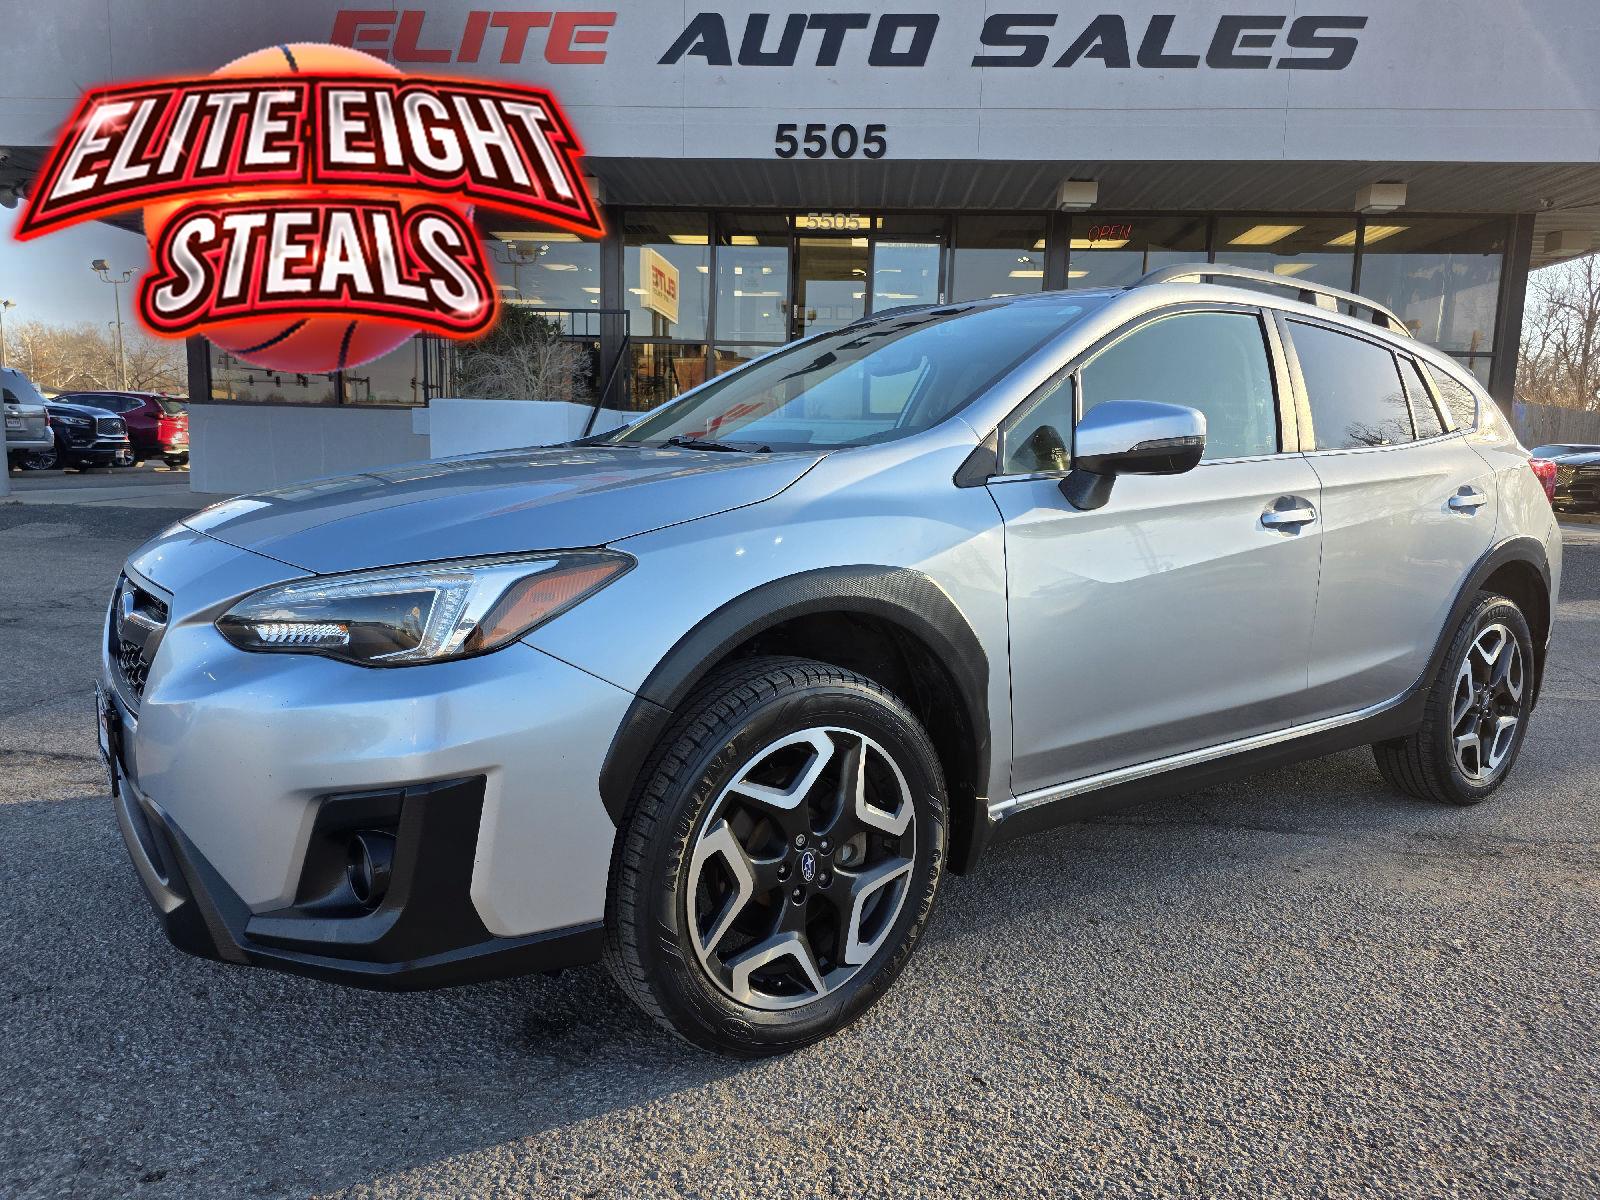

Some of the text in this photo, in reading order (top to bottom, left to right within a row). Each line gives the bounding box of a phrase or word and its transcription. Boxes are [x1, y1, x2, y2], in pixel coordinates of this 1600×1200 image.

[330, 10, 1368, 70] ELITE AUTO SALES
[774, 123, 888, 159] 5505
[806, 212, 861, 231] 5505
[1088, 223, 1133, 242] OPEN
